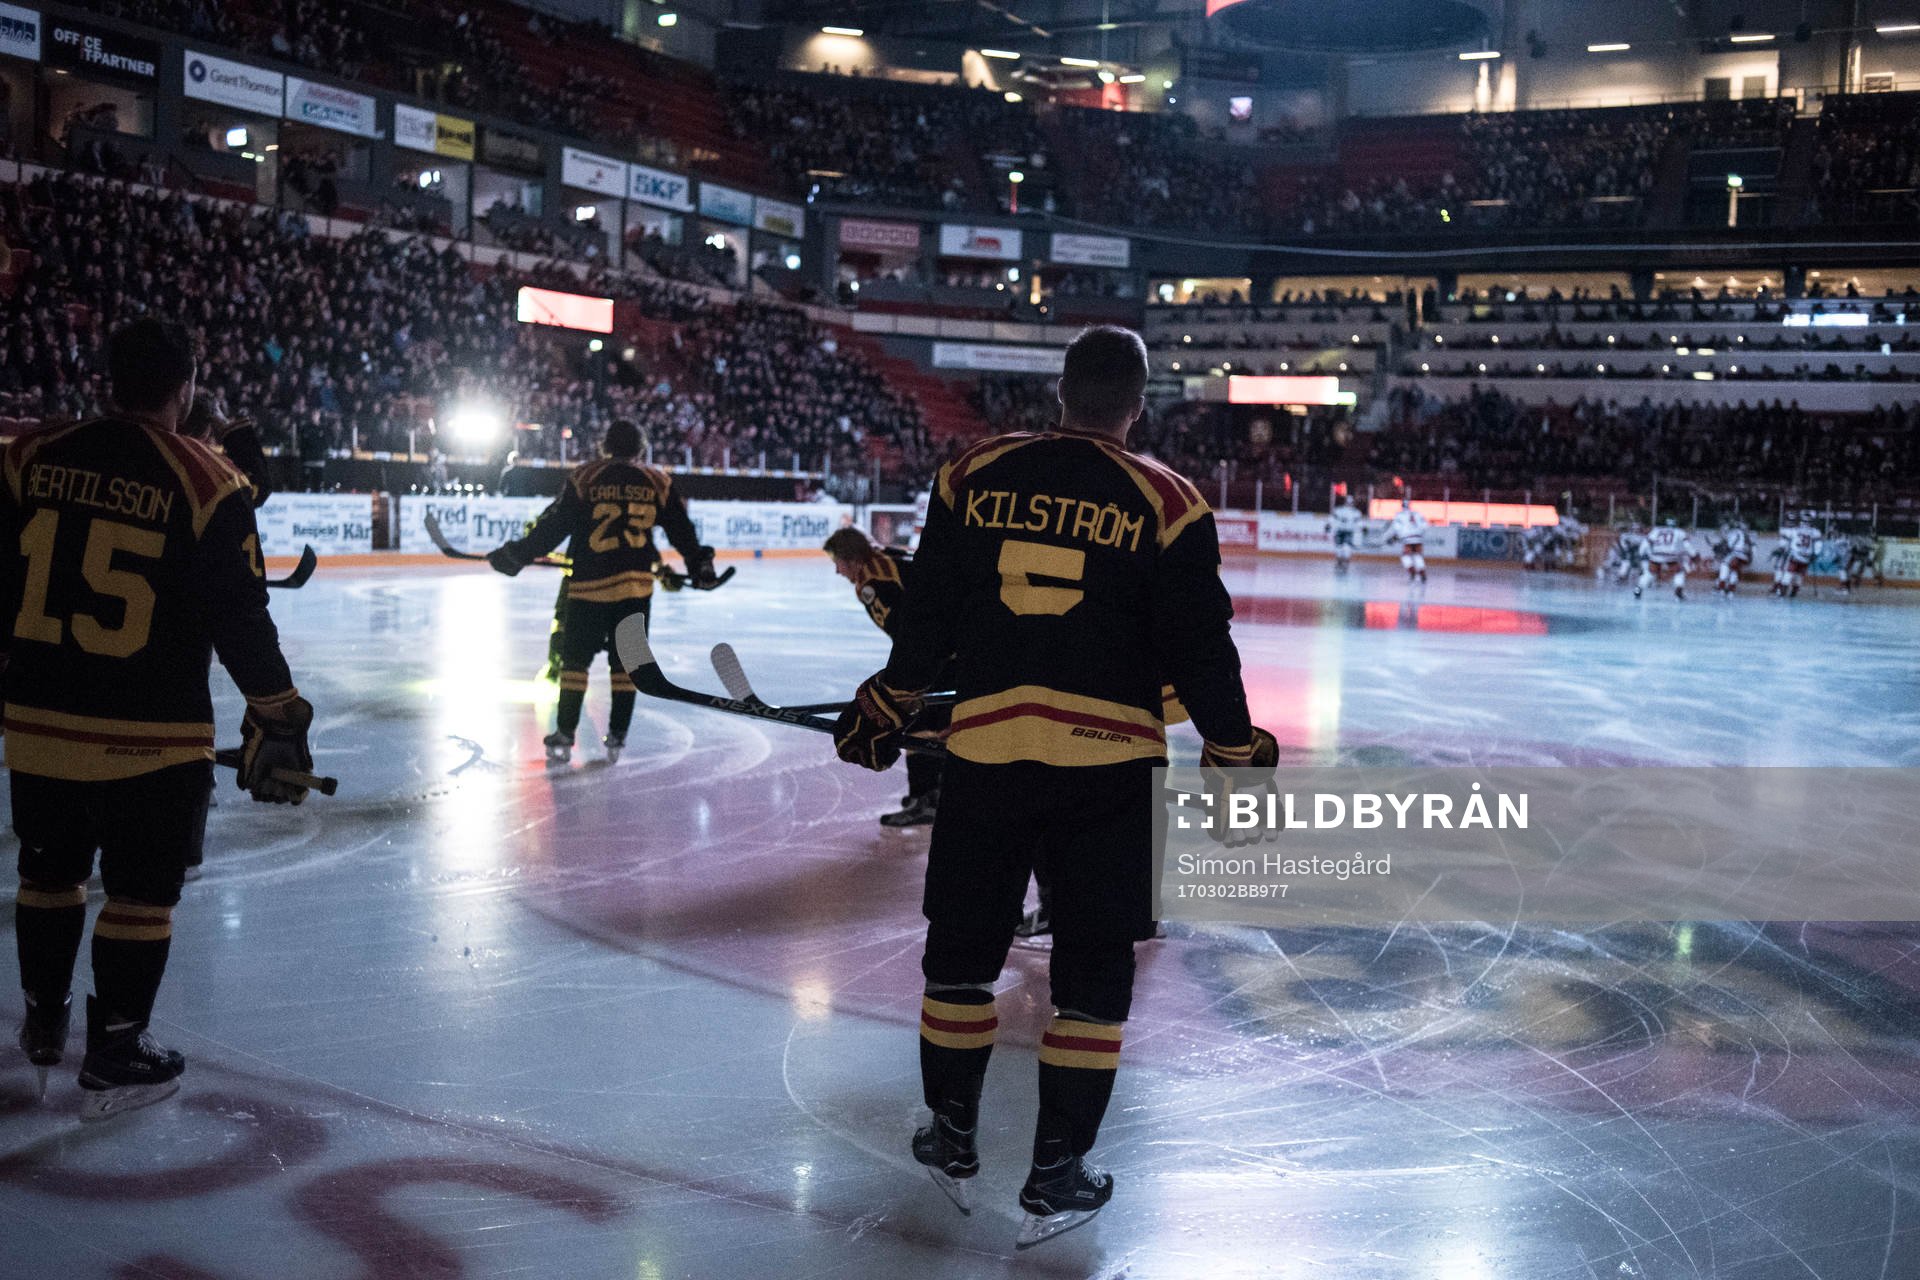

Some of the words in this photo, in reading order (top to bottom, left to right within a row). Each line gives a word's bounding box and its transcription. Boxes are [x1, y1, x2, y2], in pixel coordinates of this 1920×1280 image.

[634, 173, 683, 201] SKF
[28, 464, 174, 523] BERTILSSON
[473, 514, 526, 541] Tryg
[965, 489, 1145, 552] KILSTRÖM
[13, 507, 166, 658] 15
[710, 696, 800, 722] NEXUS
